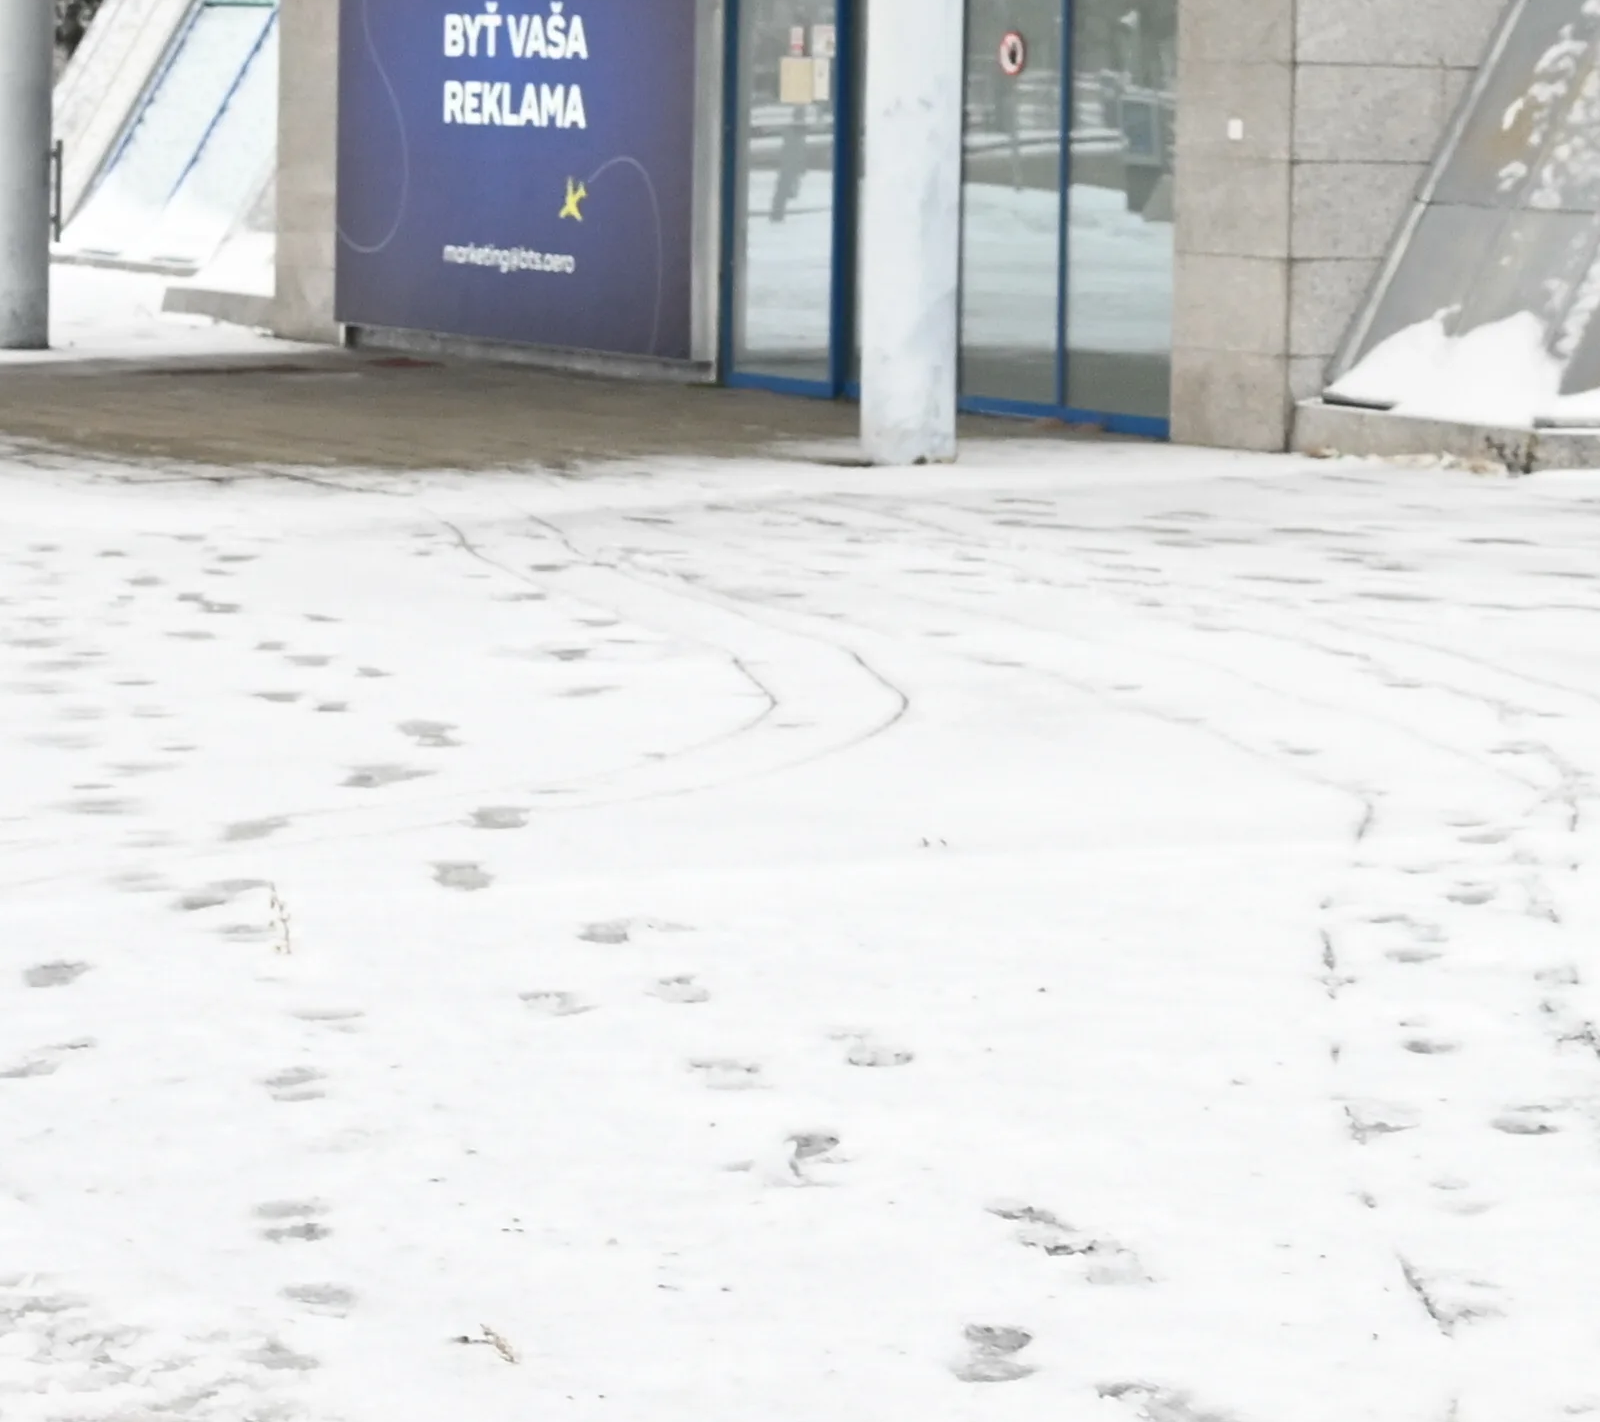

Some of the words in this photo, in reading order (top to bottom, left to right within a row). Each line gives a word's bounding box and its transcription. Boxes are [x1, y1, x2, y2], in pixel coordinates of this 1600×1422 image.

[443, 1, 503, 58] BYŤ
[507, 1, 588, 60] VAŠA
[443, 80, 587, 129] REKLAMA
[442, 243, 576, 275] marketing@bts.aero
